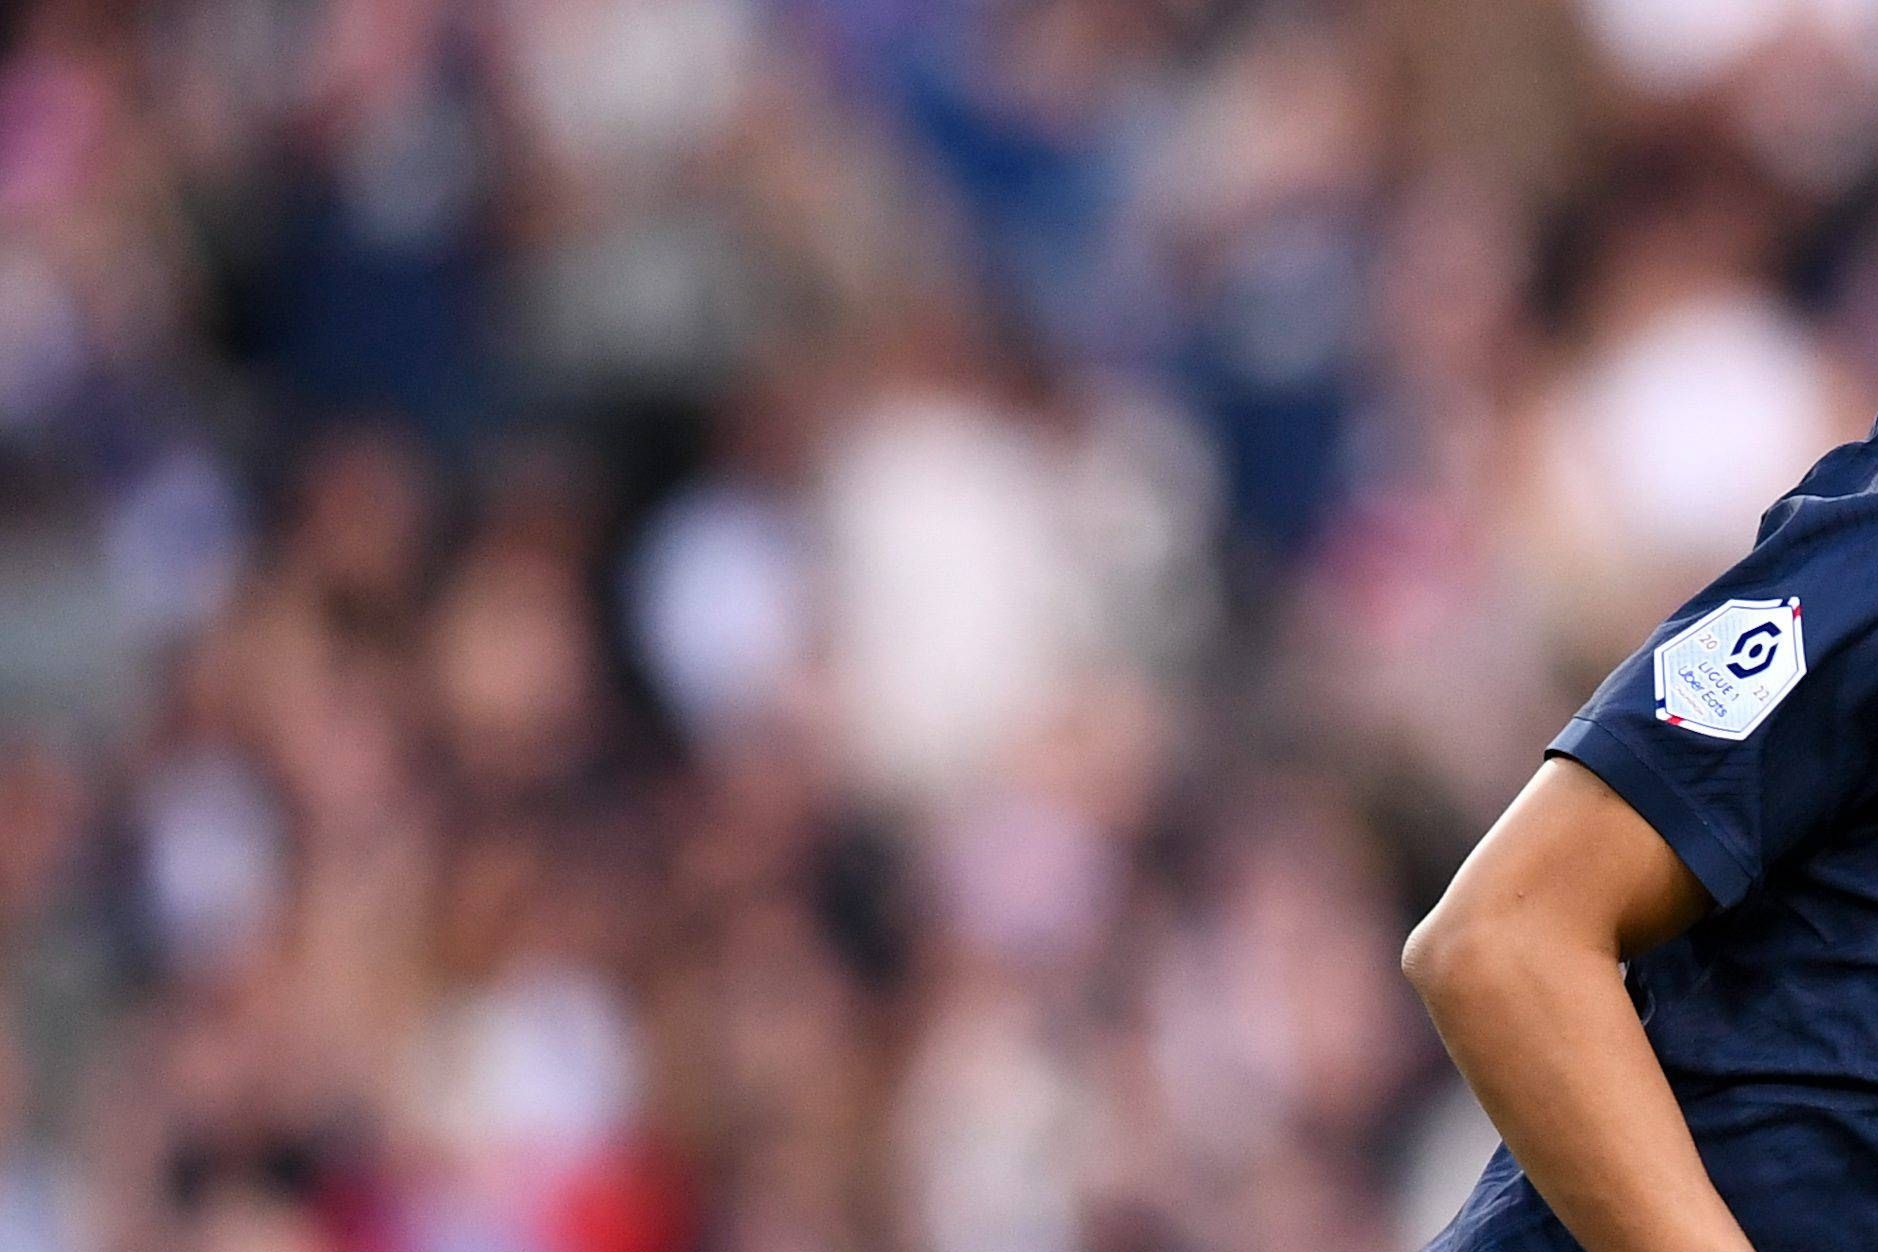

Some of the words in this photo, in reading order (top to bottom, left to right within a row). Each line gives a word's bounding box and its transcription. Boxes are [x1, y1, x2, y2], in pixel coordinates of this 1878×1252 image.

[1699, 633, 1718, 650] 20
[1678, 665, 1705, 692] Uber
[1701, 690, 1729, 718] Eats
[1698, 661, 1734, 696] LIGUE
